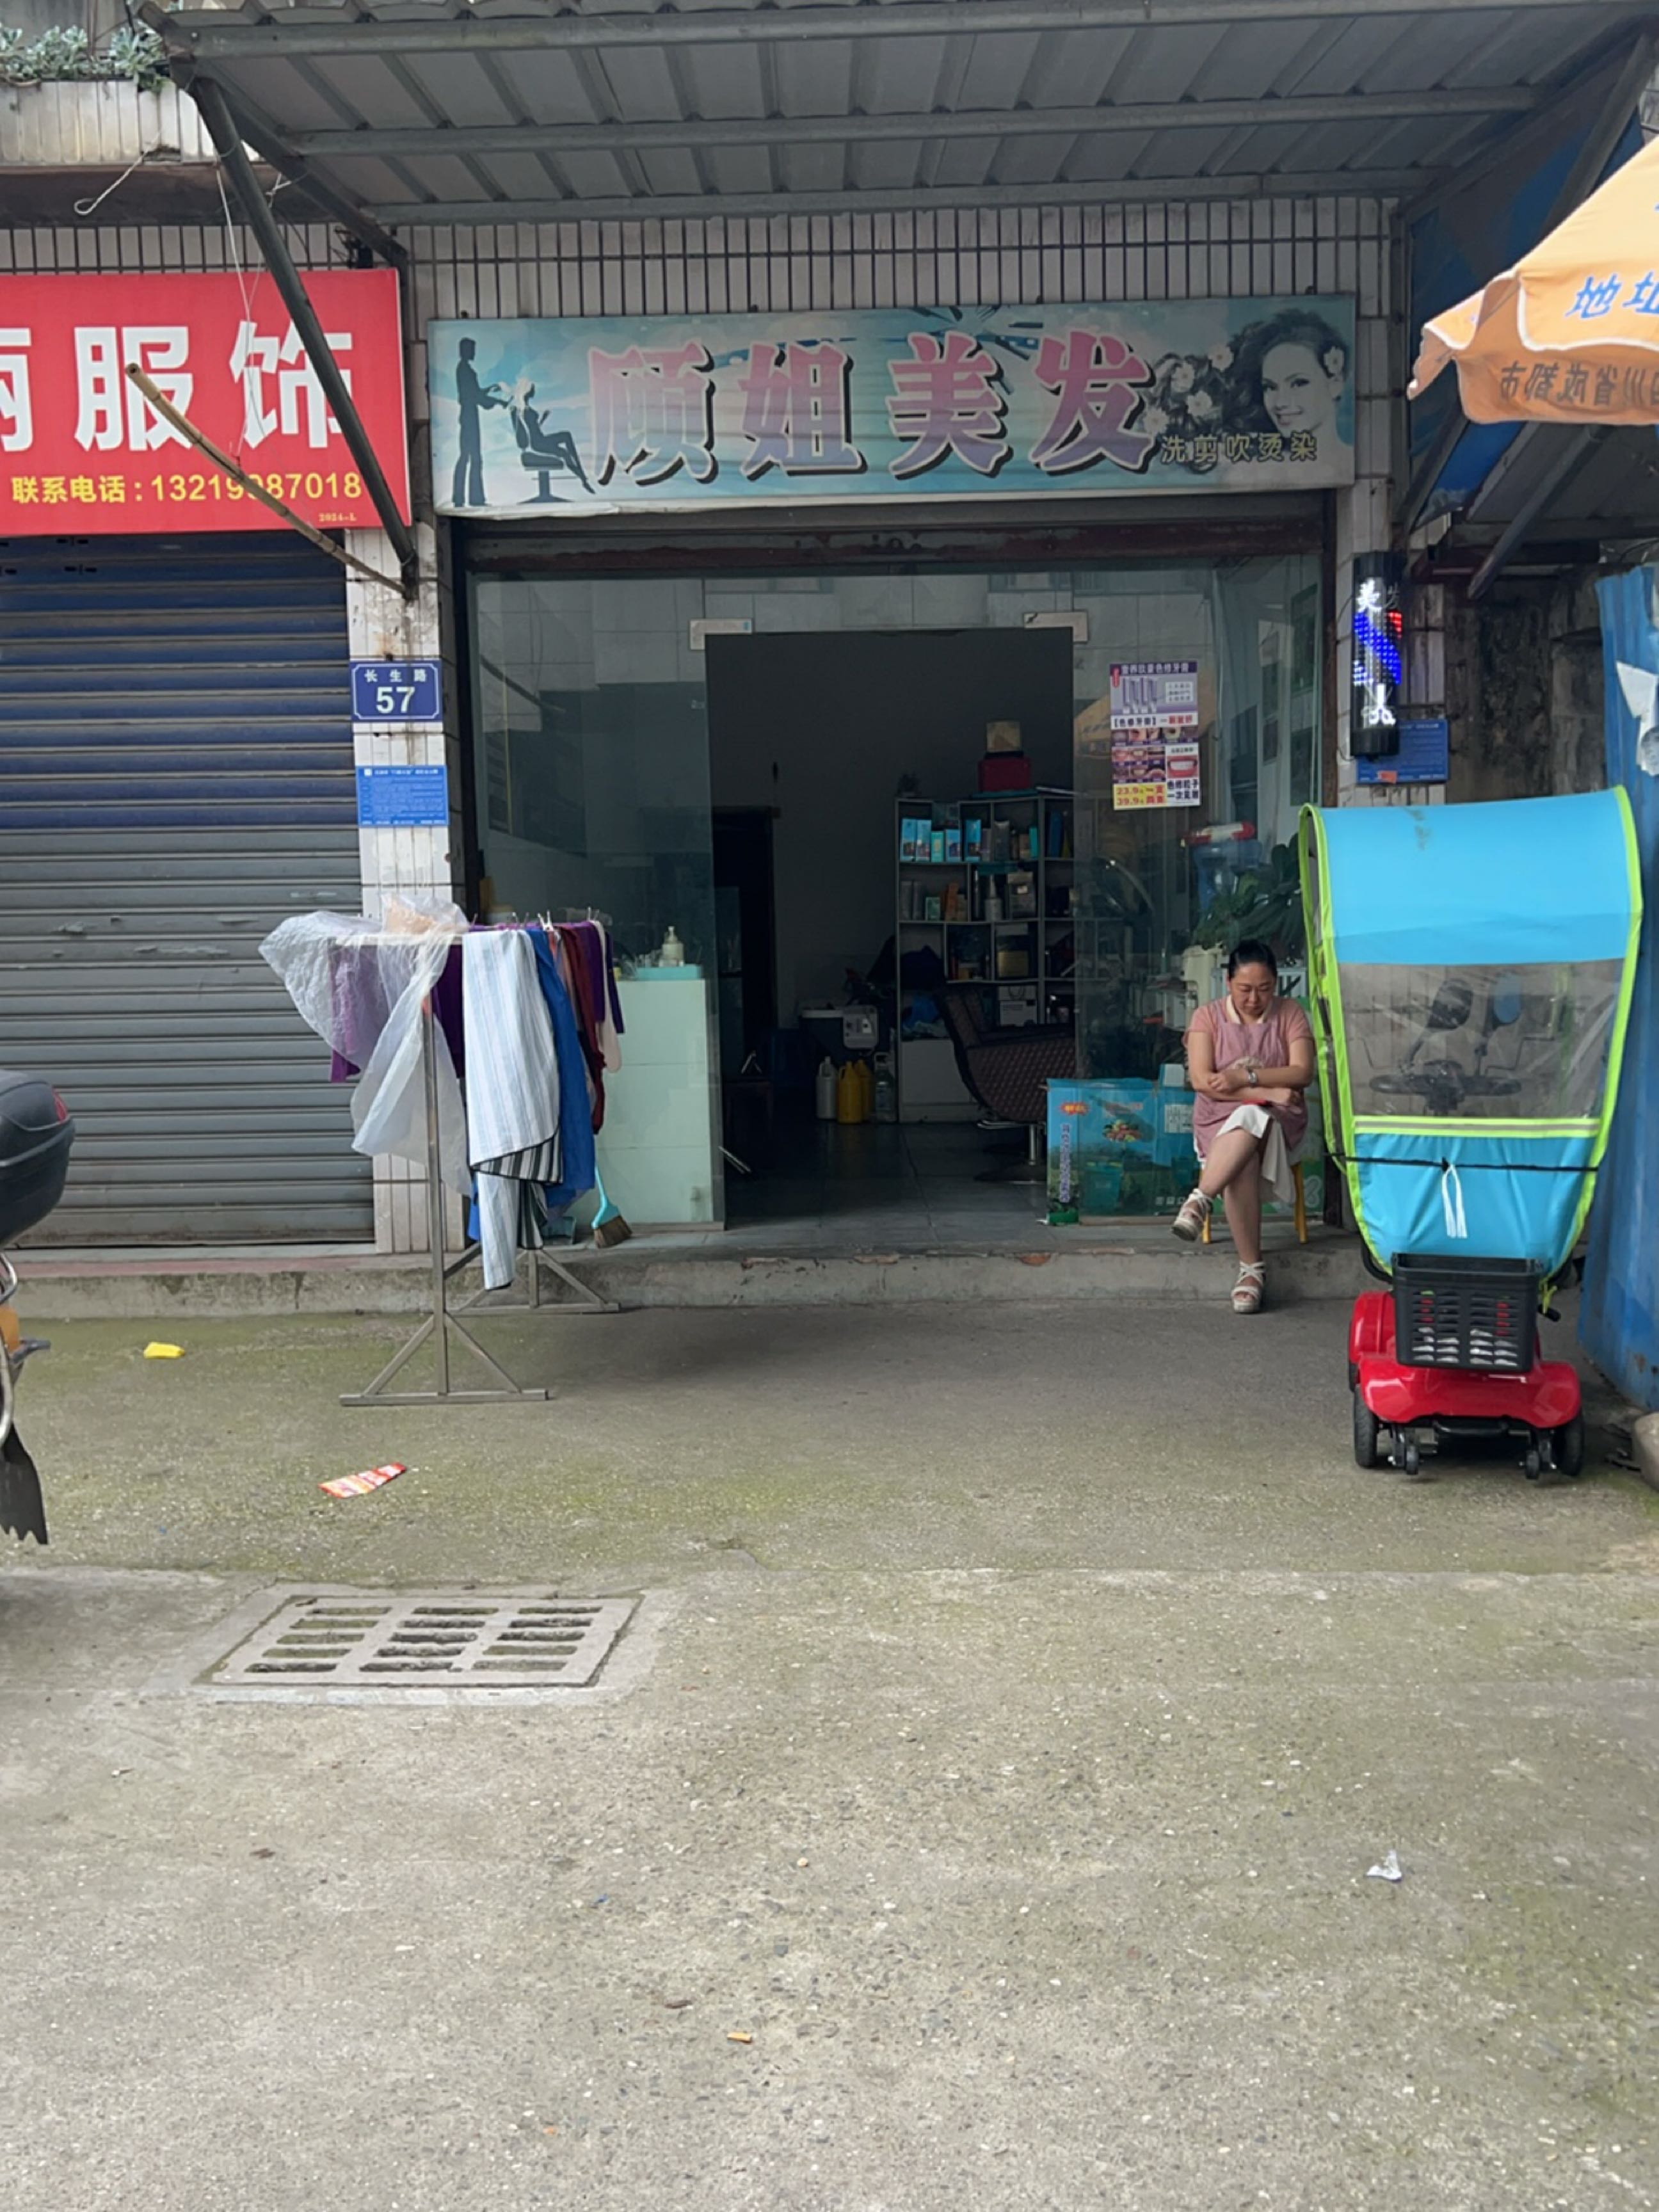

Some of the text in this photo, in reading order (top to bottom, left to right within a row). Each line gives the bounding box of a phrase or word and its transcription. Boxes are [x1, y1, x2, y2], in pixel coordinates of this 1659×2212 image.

[0, 319, 353, 452] 服饰
[588, 329, 1155, 486] 顾姐美发
[1160, 430, 1318, 464] 洗剪吹烫染
[376, 686, 415, 714] 57
